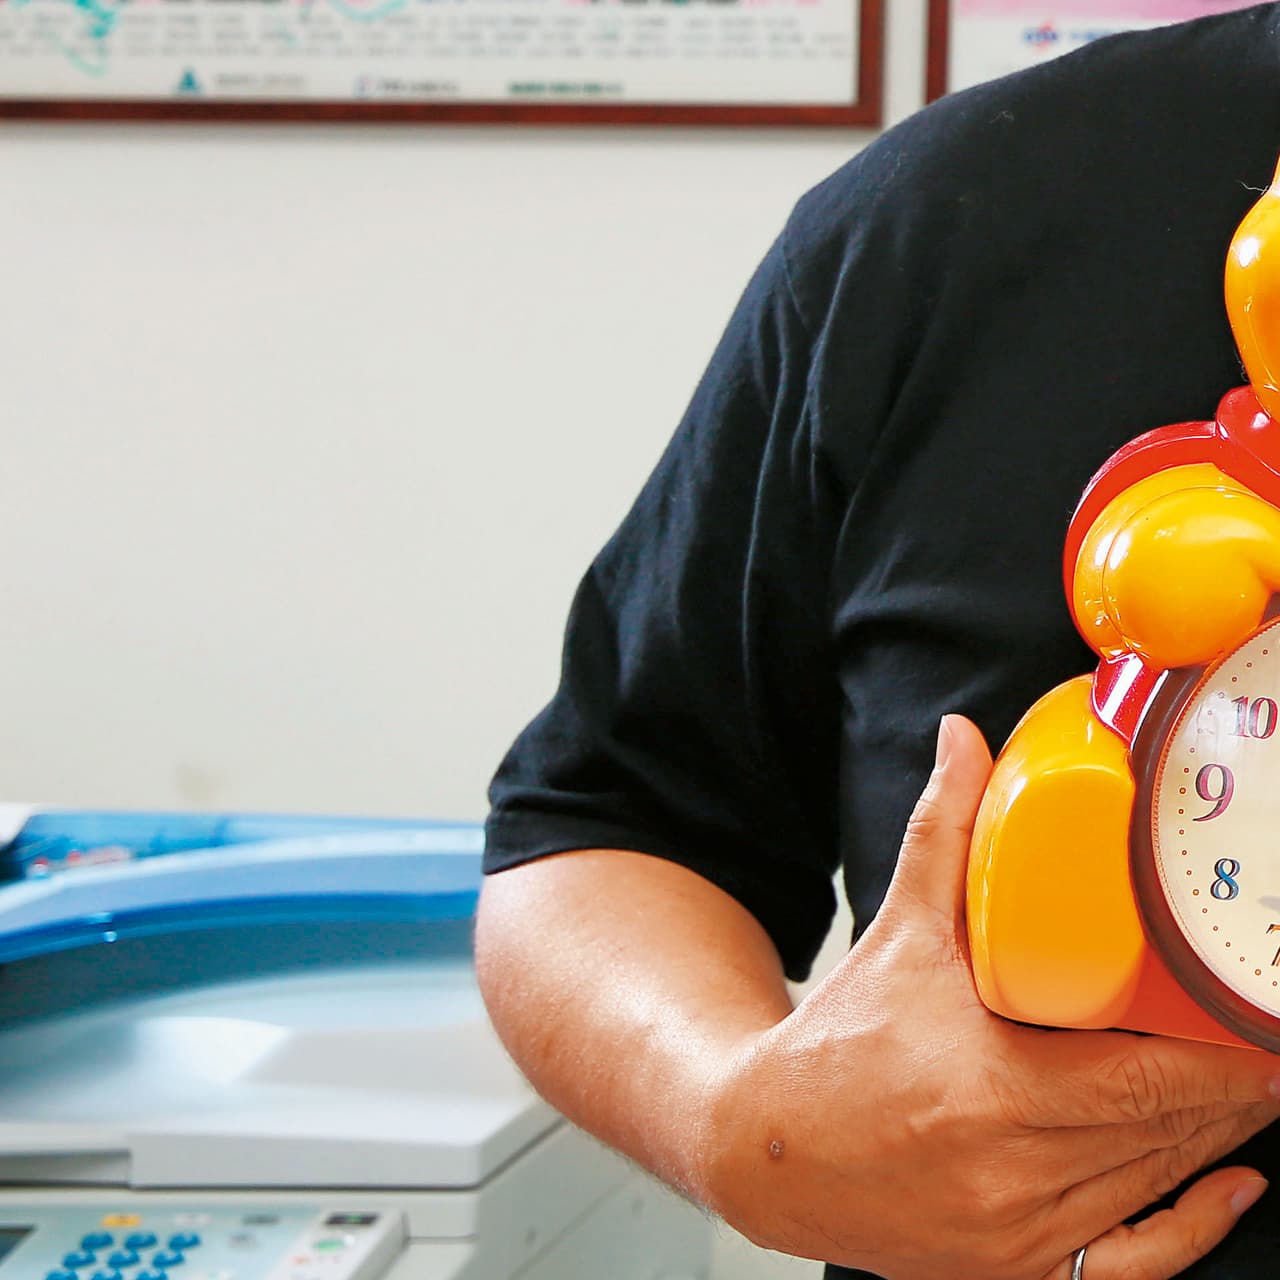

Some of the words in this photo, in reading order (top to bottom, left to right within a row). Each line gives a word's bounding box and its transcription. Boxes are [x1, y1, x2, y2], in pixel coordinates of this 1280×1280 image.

[1230, 696, 1278, 739] 10
[1193, 763, 1235, 822] 9
[1210, 858, 1241, 901] 8
